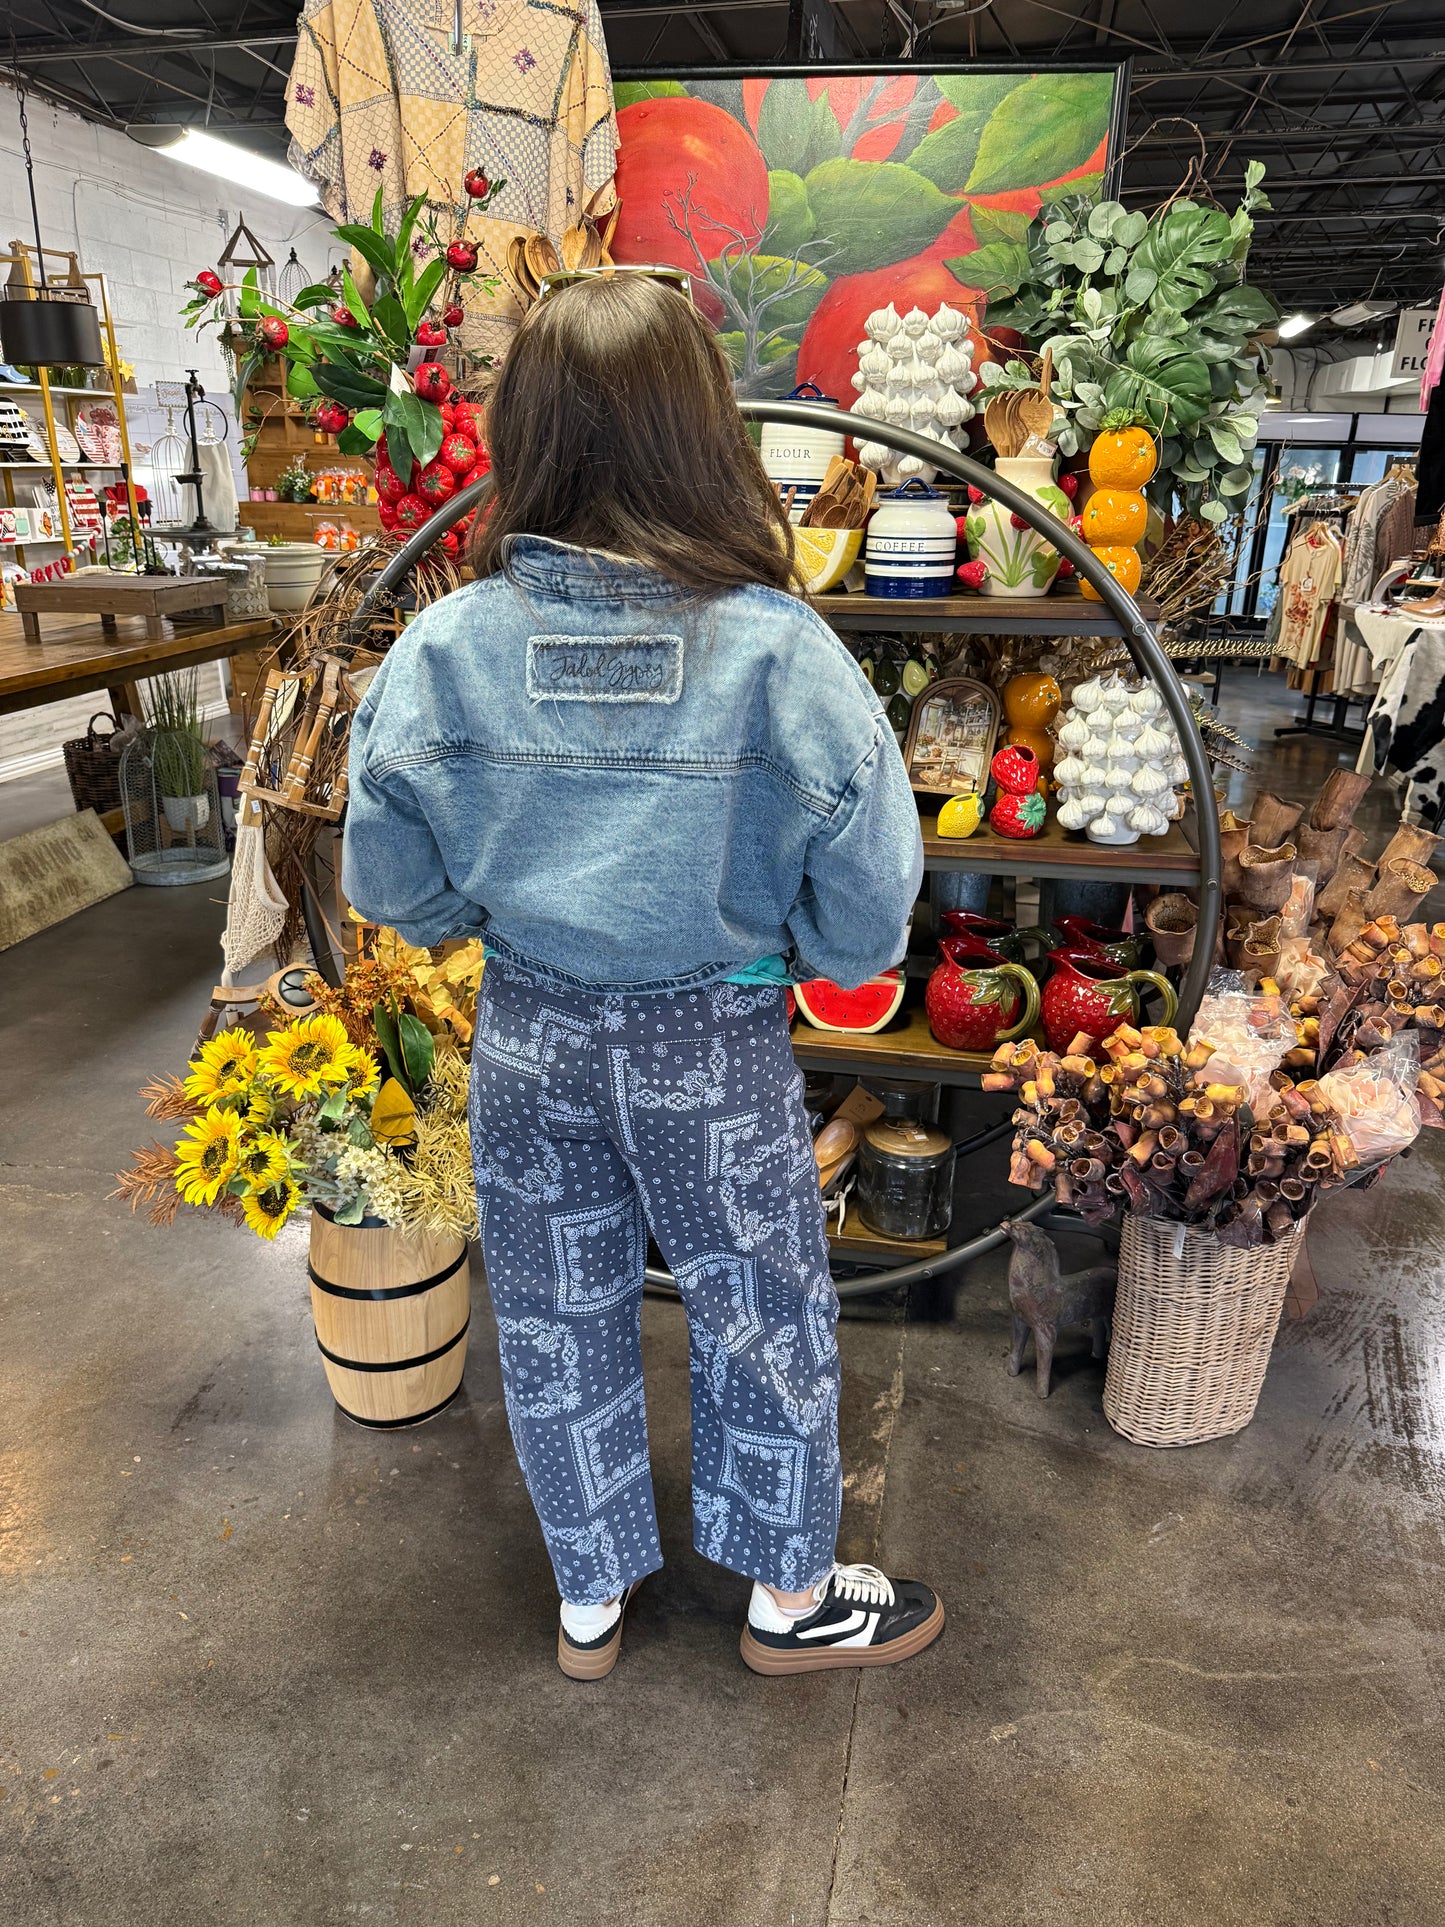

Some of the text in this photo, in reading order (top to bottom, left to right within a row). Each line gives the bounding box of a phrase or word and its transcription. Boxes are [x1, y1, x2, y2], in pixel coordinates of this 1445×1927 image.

[769, 448, 812, 459] FLOUR
[875, 541, 925, 552] COFFEE
[606, 656, 663, 689] Gypsy
